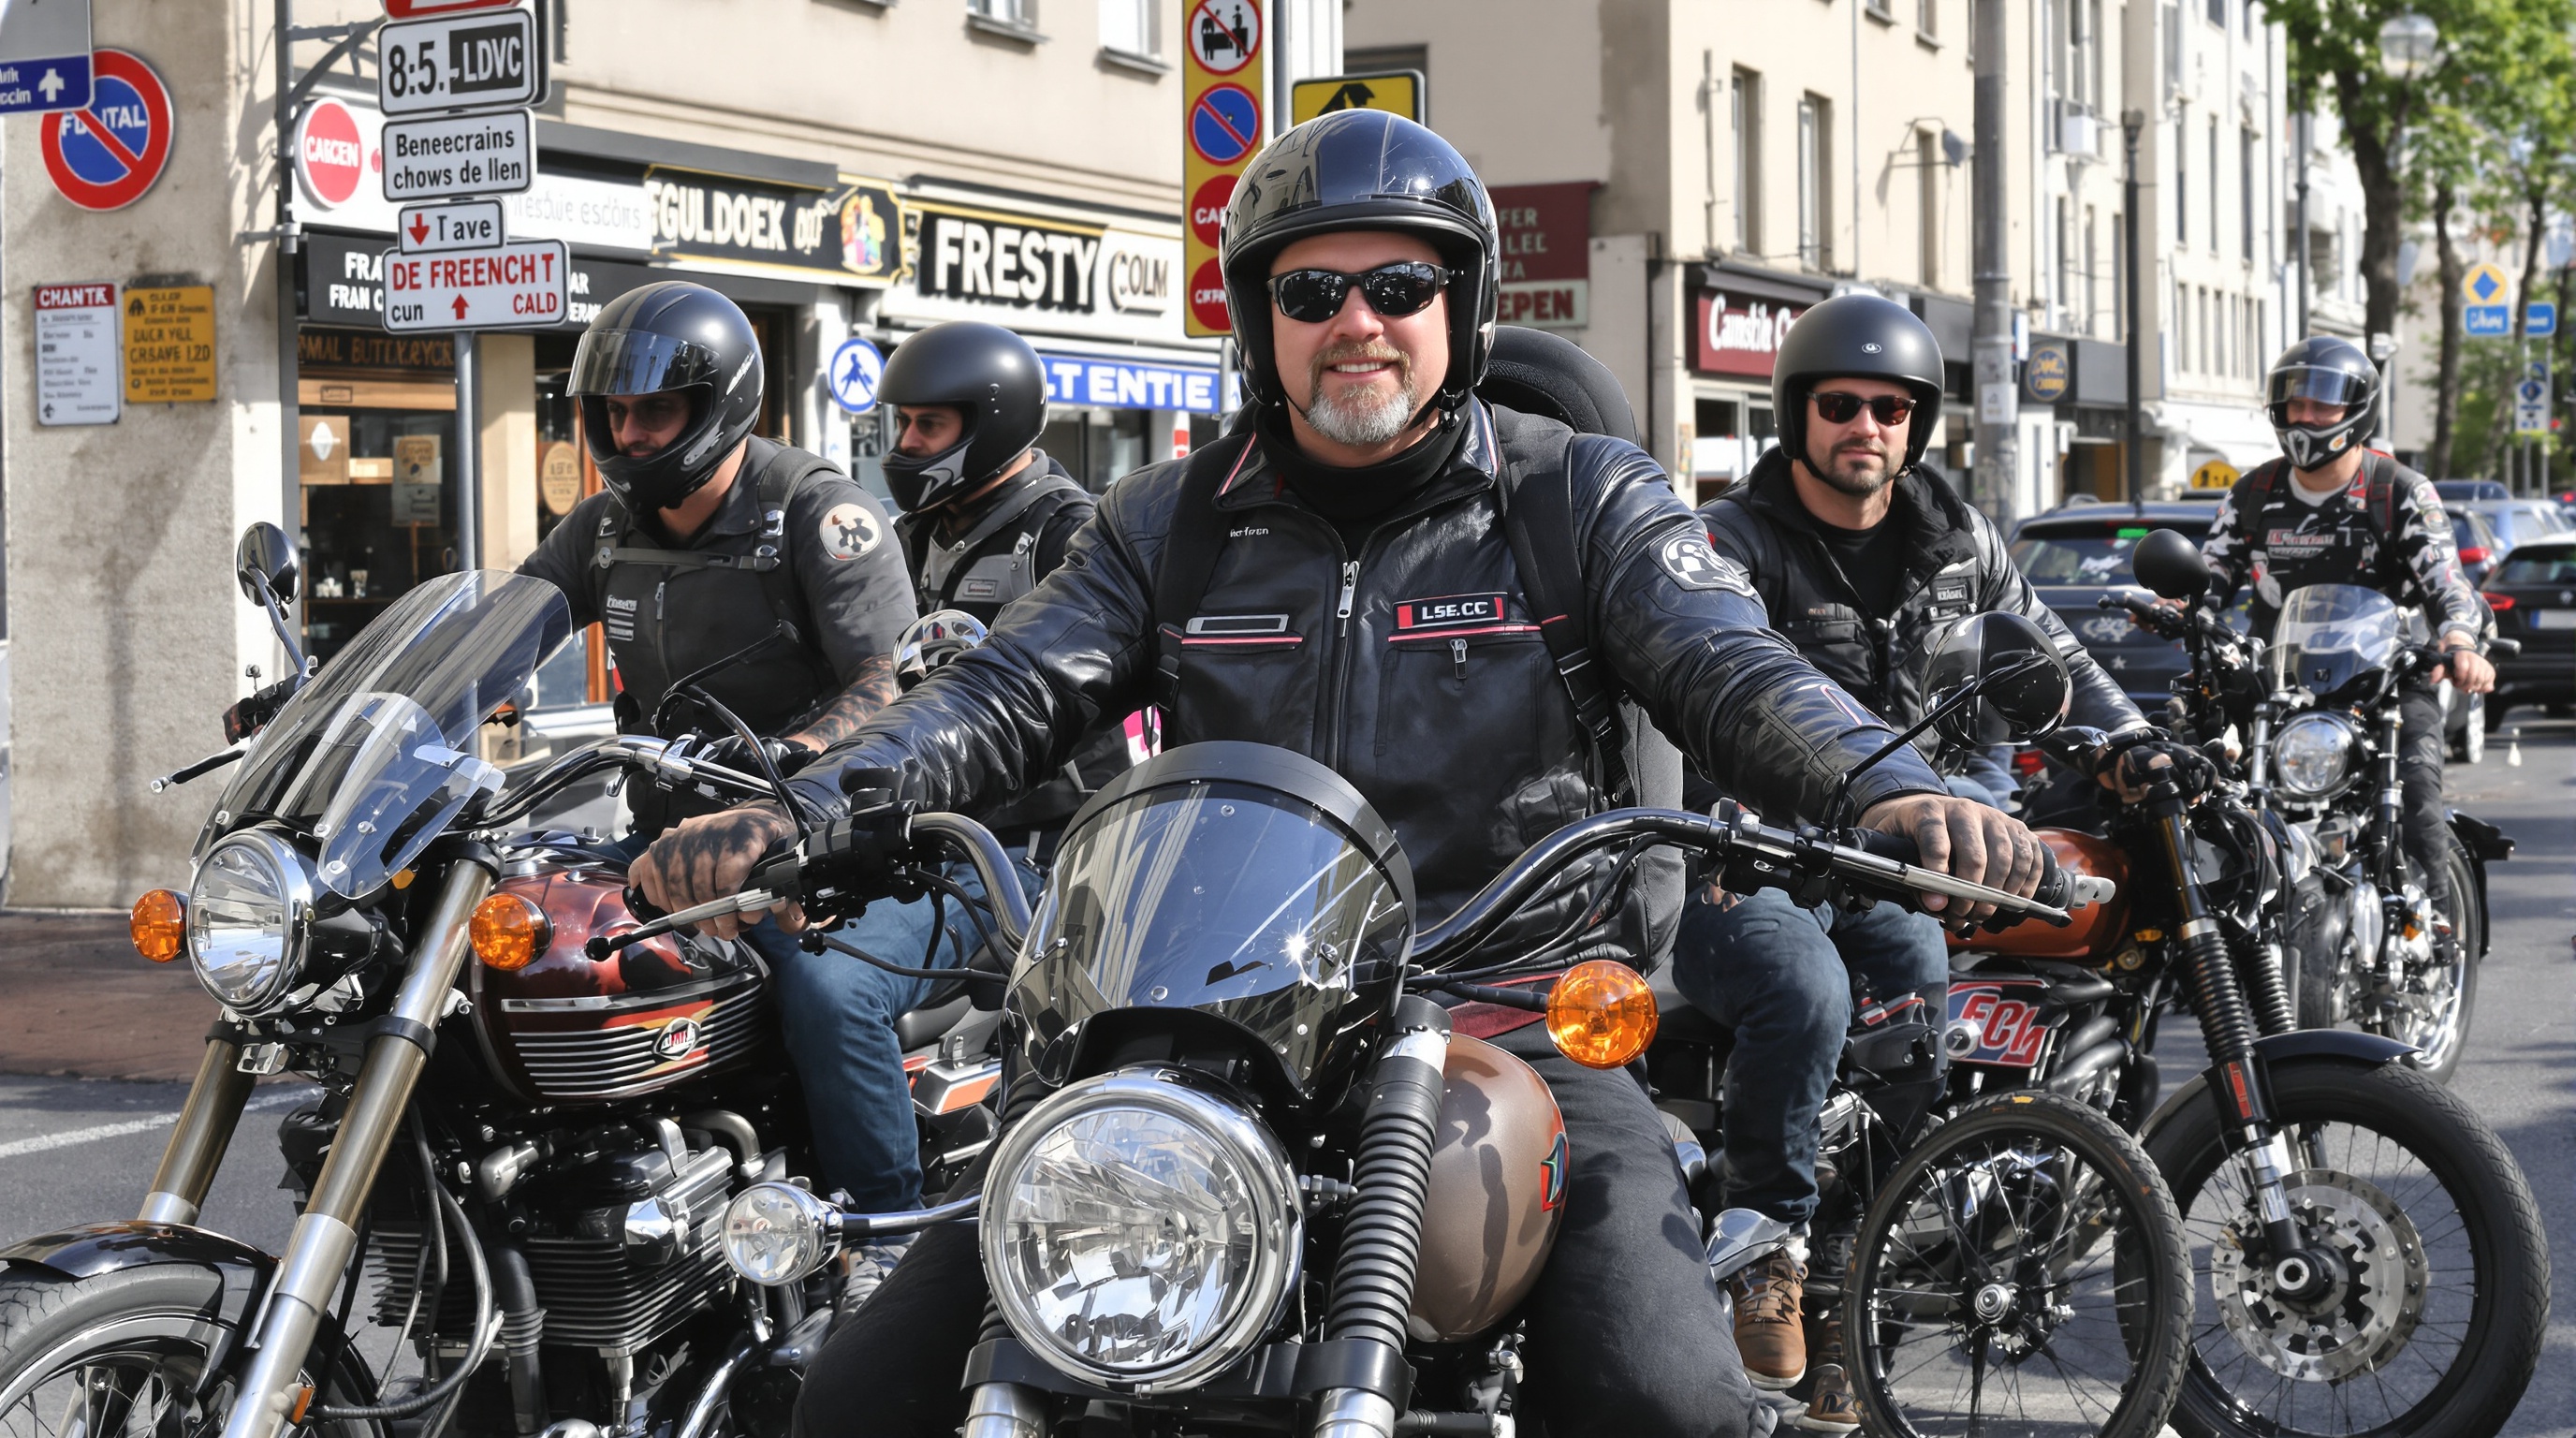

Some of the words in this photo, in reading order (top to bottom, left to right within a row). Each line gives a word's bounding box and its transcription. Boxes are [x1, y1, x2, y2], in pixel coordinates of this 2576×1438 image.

[396, 126, 515, 158] Beneecrains
[393, 164, 453, 190] chows
[460, 159, 483, 184] de
[453, 219, 492, 241] ave
[392, 261, 422, 291] DE
[431, 254, 536, 288] FREENCH
[541, 253, 555, 283] T
[934, 217, 1098, 309] FRESTY
[391, 302, 424, 322] cun
[513, 292, 558, 315] CALD
[1088, 365, 1213, 410] ENTIE
